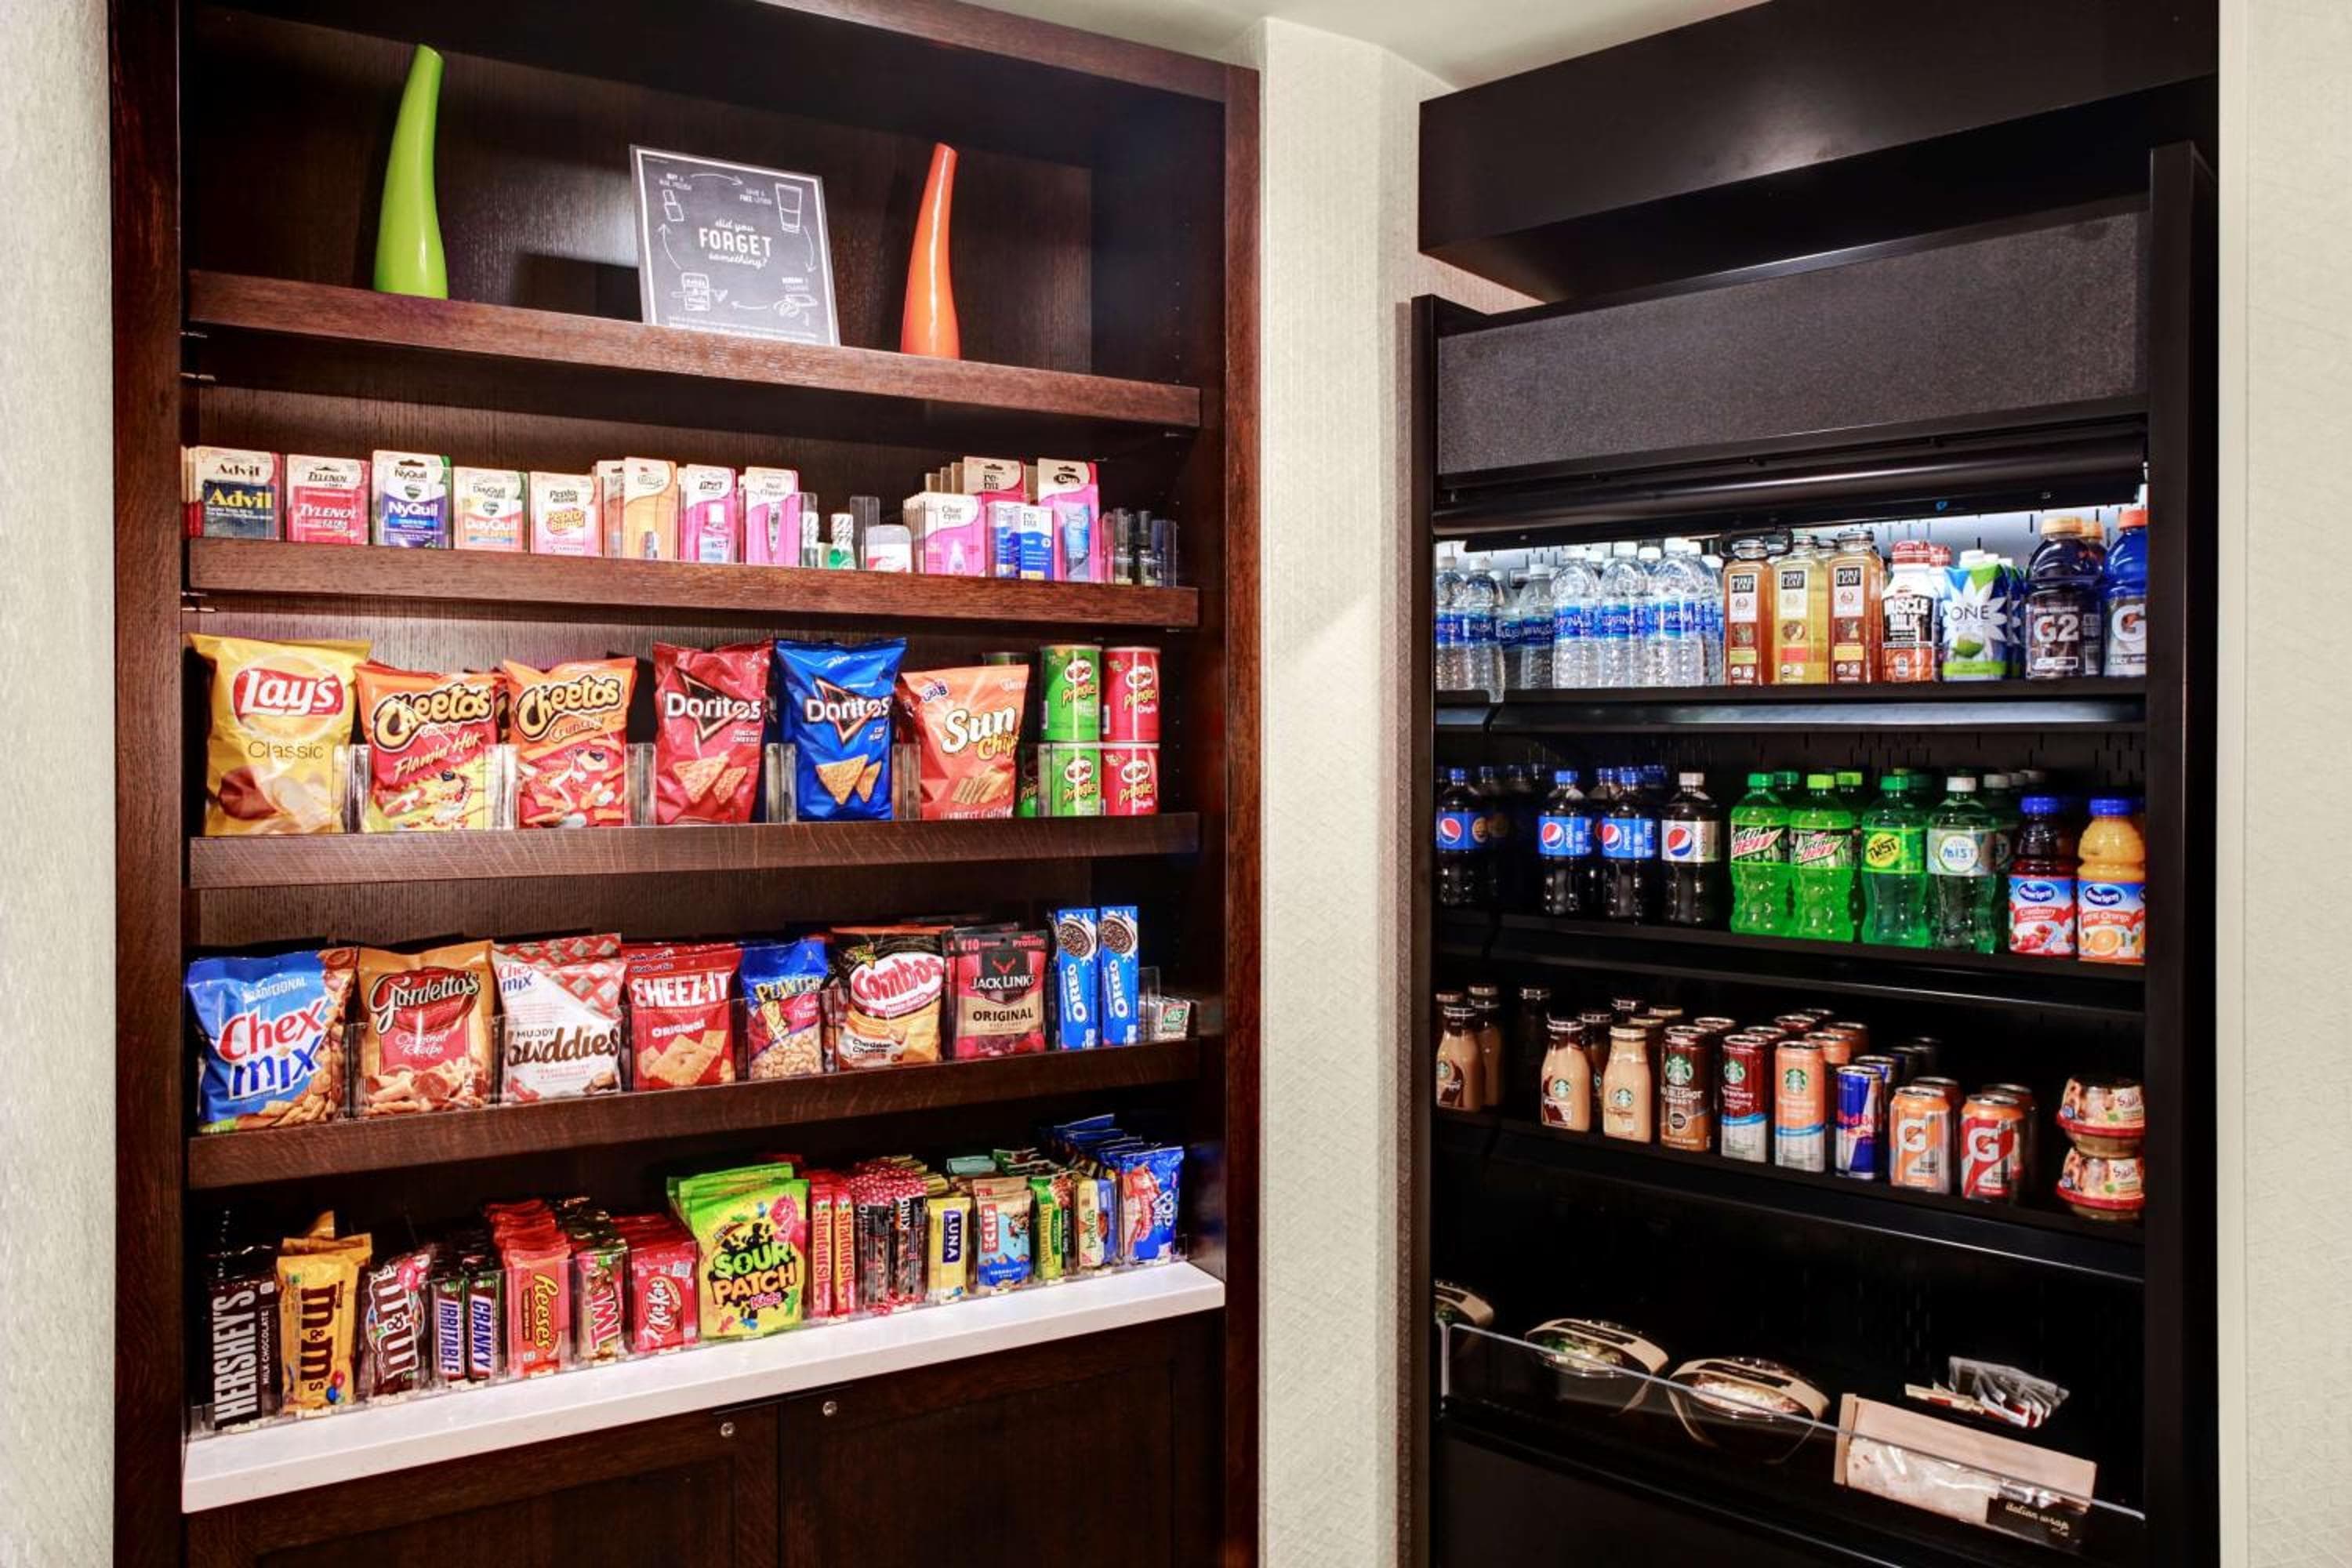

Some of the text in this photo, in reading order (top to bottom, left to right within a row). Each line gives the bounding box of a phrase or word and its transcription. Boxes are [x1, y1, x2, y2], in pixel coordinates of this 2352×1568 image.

[715, 218, 754, 233] did you
[699, 228, 772, 257] FORGET
[709, 252, 768, 270] something?
[216, 463, 260, 477] Advil
[394, 468, 427, 481] NyQuil
[209, 488, 272, 509] Advil
[473, 485, 506, 495] DayQuil
[299, 504, 358, 518] TYLENOL
[388, 501, 438, 519] NyQuil
[465, 517, 518, 532] DayQuil
[2034, 614, 2078, 642] G2
[2111, 604, 2147, 641] G
[239, 669, 339, 717] Lay's
[516, 675, 622, 739] Cheetos
[666, 691, 762, 720] Doritos
[806, 697, 891, 722] Doritos
[373, 683, 495, 750] Cheetos
[942, 706, 1018, 753] Sun
[248, 740, 324, 760] Classic
[452, 732, 484, 753] Hot
[243, 976, 307, 1004] TRADITIONAL
[502, 974, 533, 993] mix
[851, 956, 945, 1001] Combos
[971, 977, 1003, 990] JACK
[1067, 963, 1087, 1023] OREO
[1109, 959, 1129, 1018] OREO
[369, 971, 481, 1033] Gardetto's
[972, 1007, 1034, 1022] ORIGINAL
[220, 1000, 324, 1061] Chex
[395, 1030, 450, 1047] Original
[517, 1028, 554, 1039] MUDDY
[233, 1036, 321, 1098] mix
[1896, 1118, 1927, 1152] G
[1968, 1126, 2001, 1162] G
[900, 1196, 910, 1230] KIND
[984, 1209, 996, 1242] CLIF
[814, 1211, 832, 1282] Starburst
[837, 1211, 854, 1281] Starburst
[947, 1214, 960, 1259] LUNA
[714, 1241, 793, 1277] SOUR
[712, 1262, 797, 1303] PATCH
[533, 1273, 559, 1348] Reese's
[439, 1302, 459, 1373] IRRITABLE
[471, 1301, 492, 1369] CRANKY
[212, 1289, 258, 1422] HERSHEY'S
[262, 1365, 270, 1385] MILK
[2005, 1501, 2069, 1531] italian wrap
